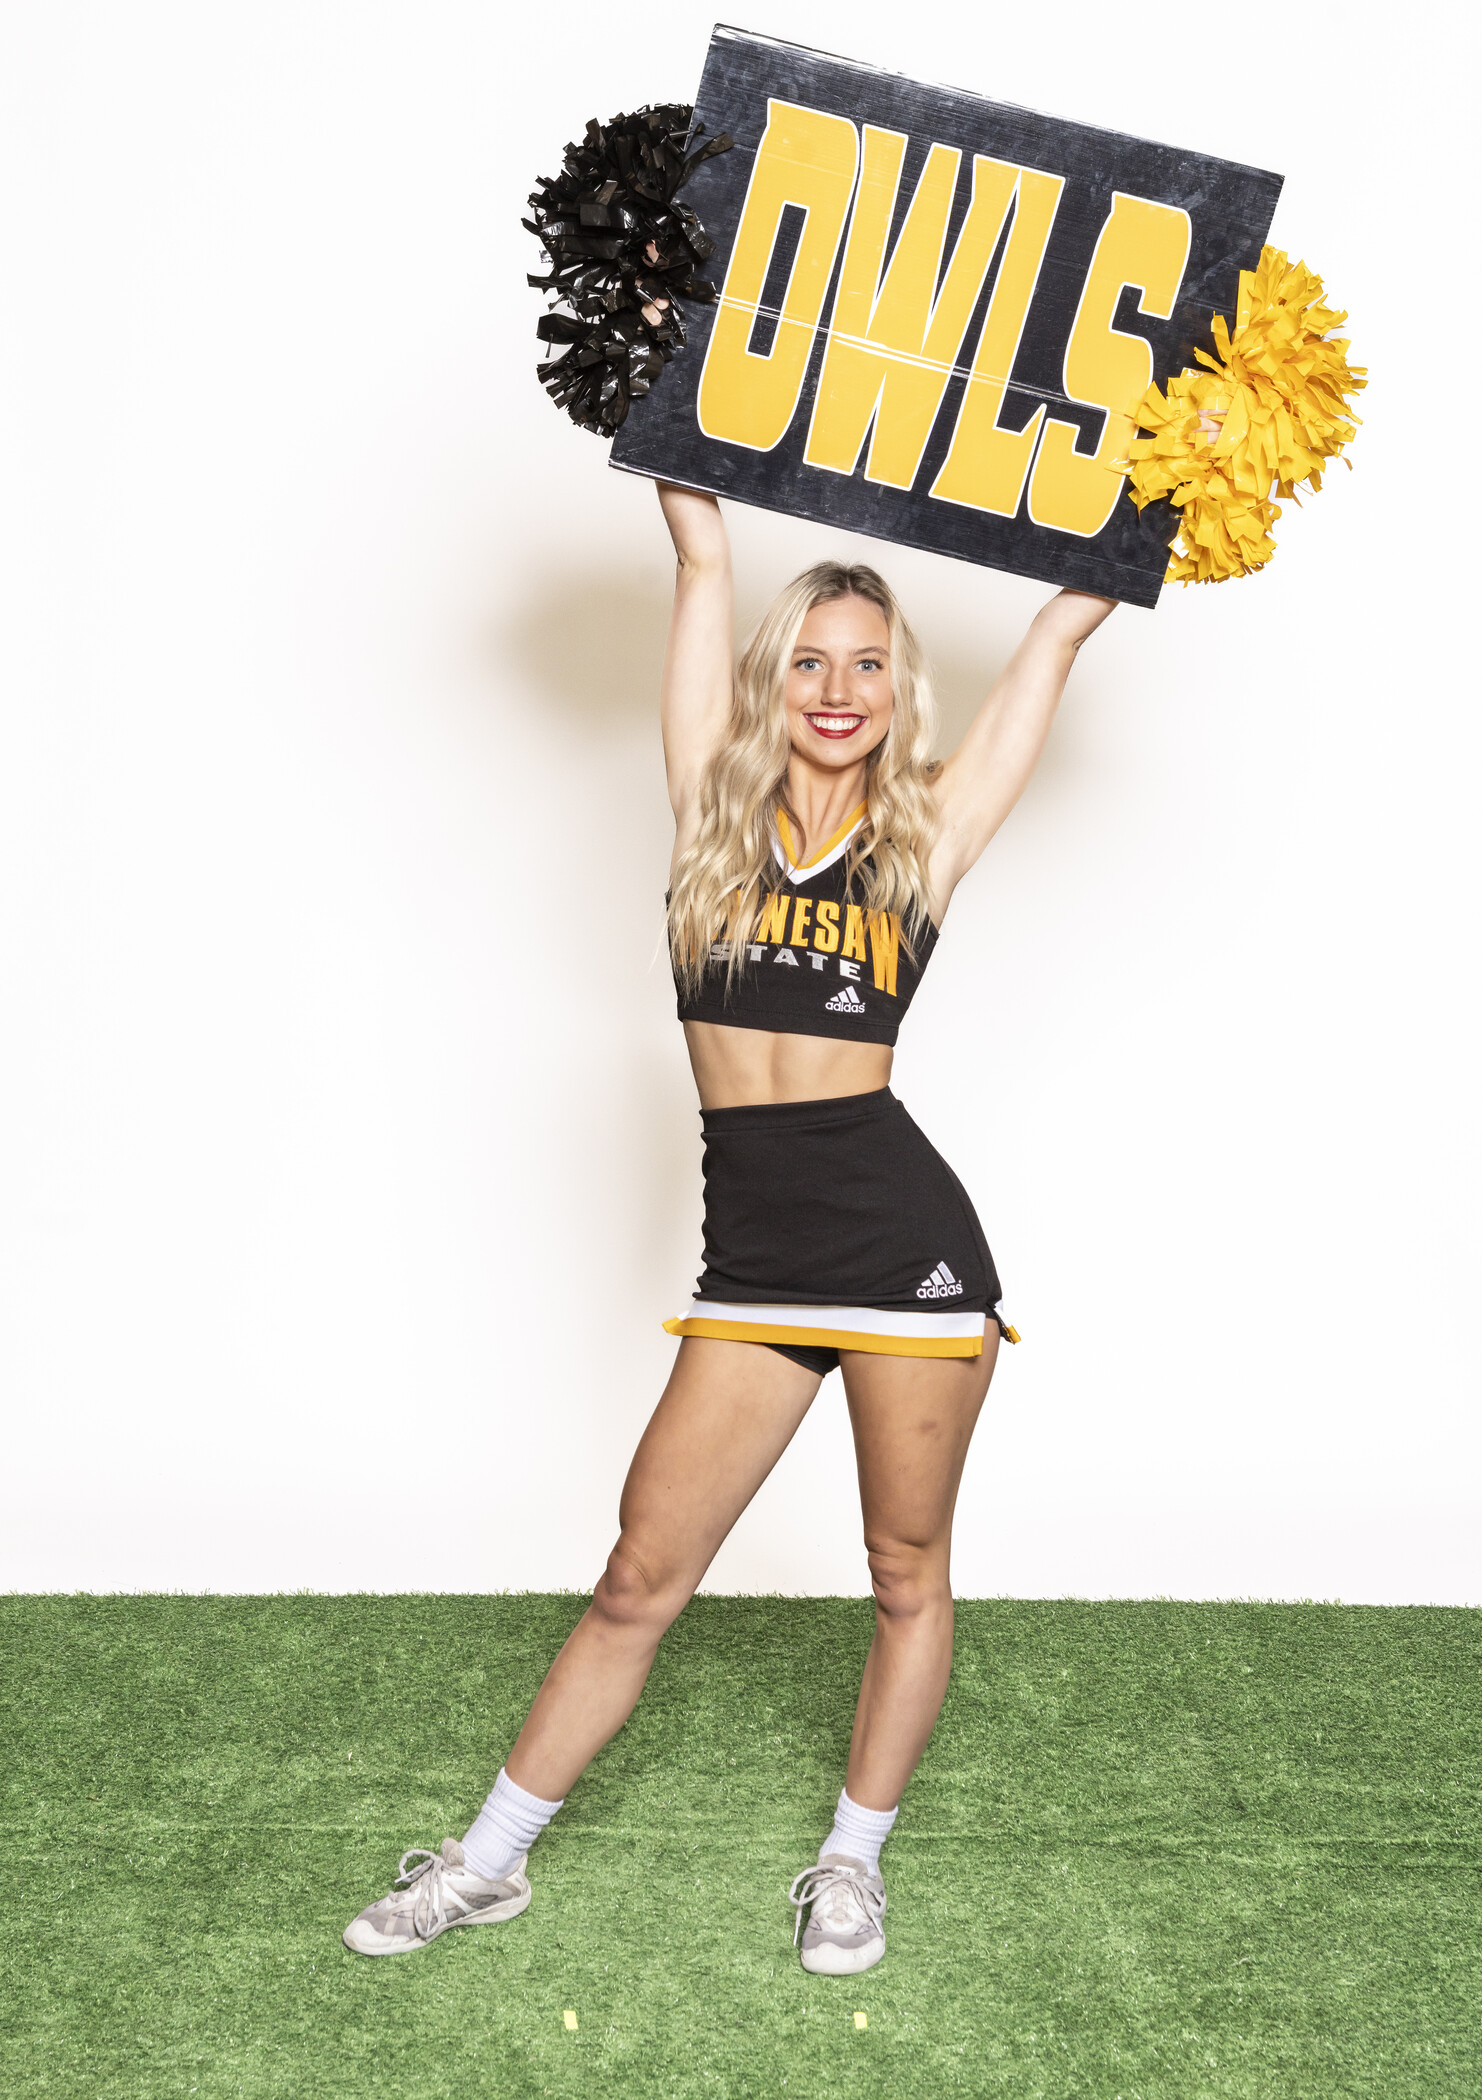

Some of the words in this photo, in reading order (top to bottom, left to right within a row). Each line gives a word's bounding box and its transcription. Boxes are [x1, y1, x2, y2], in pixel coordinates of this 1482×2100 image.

[696, 97, 1192, 538] OWLS
[677, 888, 900, 998] NESAW
[709, 943, 862, 982] STATE
[825, 1001, 866, 1014] adidas
[916, 1283, 964, 1299] adidas
